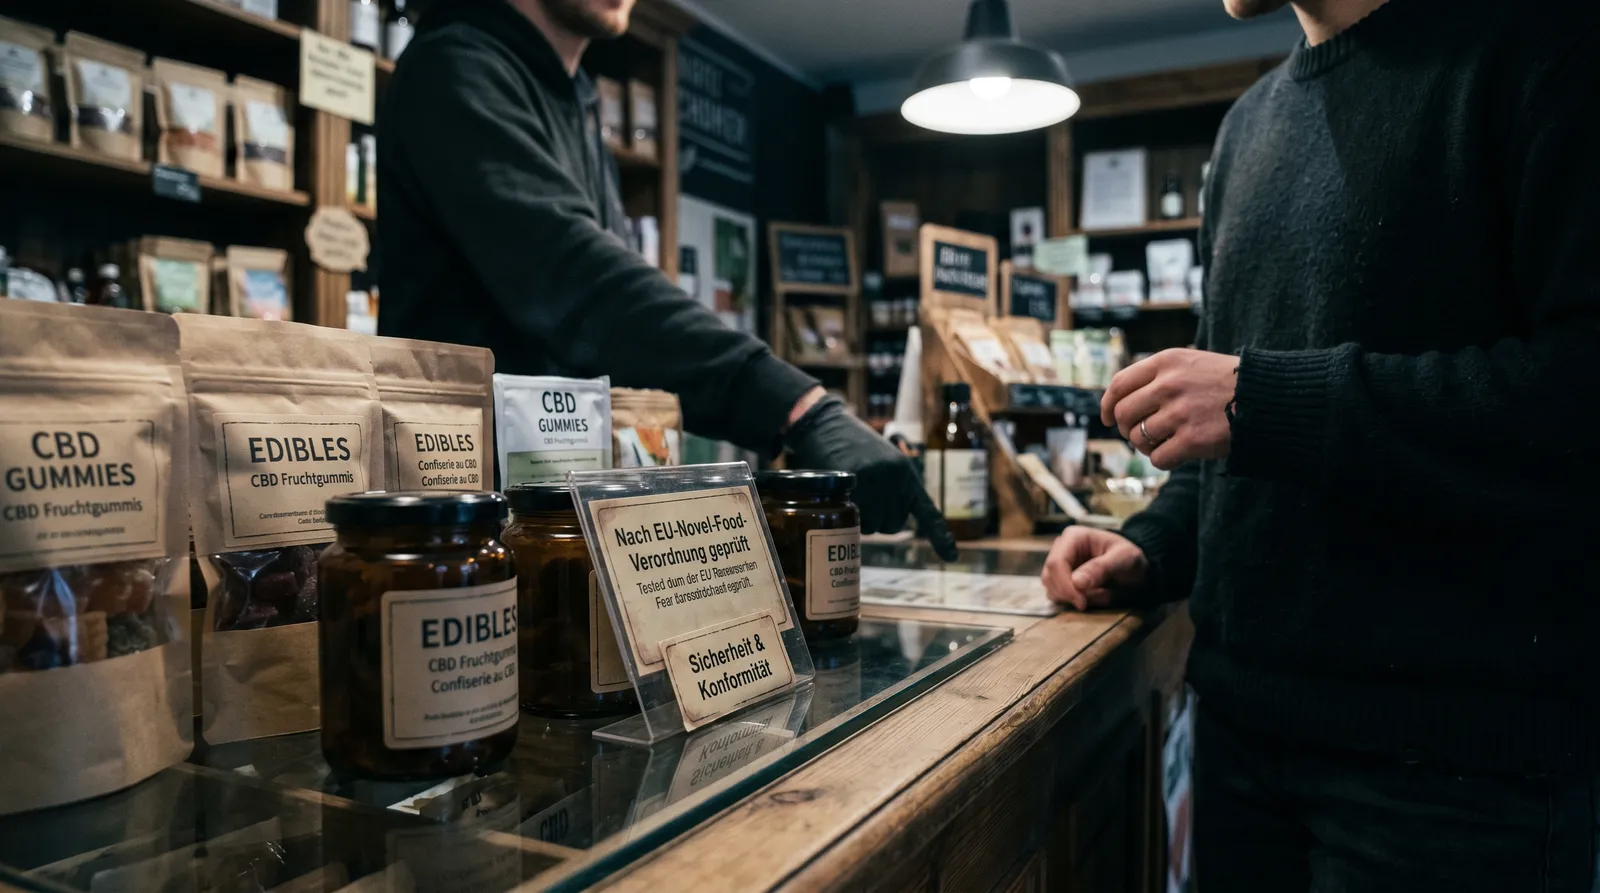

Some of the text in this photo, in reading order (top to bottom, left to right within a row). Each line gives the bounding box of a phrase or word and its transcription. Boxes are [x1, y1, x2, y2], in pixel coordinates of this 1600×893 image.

[542, 390, 576, 414] CBD
[538, 418, 589, 433] GUMMIES
[31, 431, 100, 460] CBD
[248, 436, 351, 464] EDIBLES
[414, 433, 474, 453] EDIBLES
[418, 459, 478, 471] Confiserie au CBD
[5, 463, 136, 493] GUMMIES
[250, 470, 354, 488] CBD Fruchtgummis
[421, 474, 480, 487] Confiserie au CBD
[3, 497, 144, 521] CBD Fruchtgummis
[614, 511, 748, 548] Nach EU-Novel-Food-
[629, 534, 751, 572] Verordnung geprüft
[636, 577, 666, 595] Tested
[687, 573, 699, 585] der
[700, 569, 712, 582] EU
[421, 604, 517, 650] EDIBLES
[428, 656, 457, 673] CBD
[688, 633, 766, 675] Sicherheit &
[431, 671, 492, 694] Confiserie
[697, 658, 773, 701] Konformität
